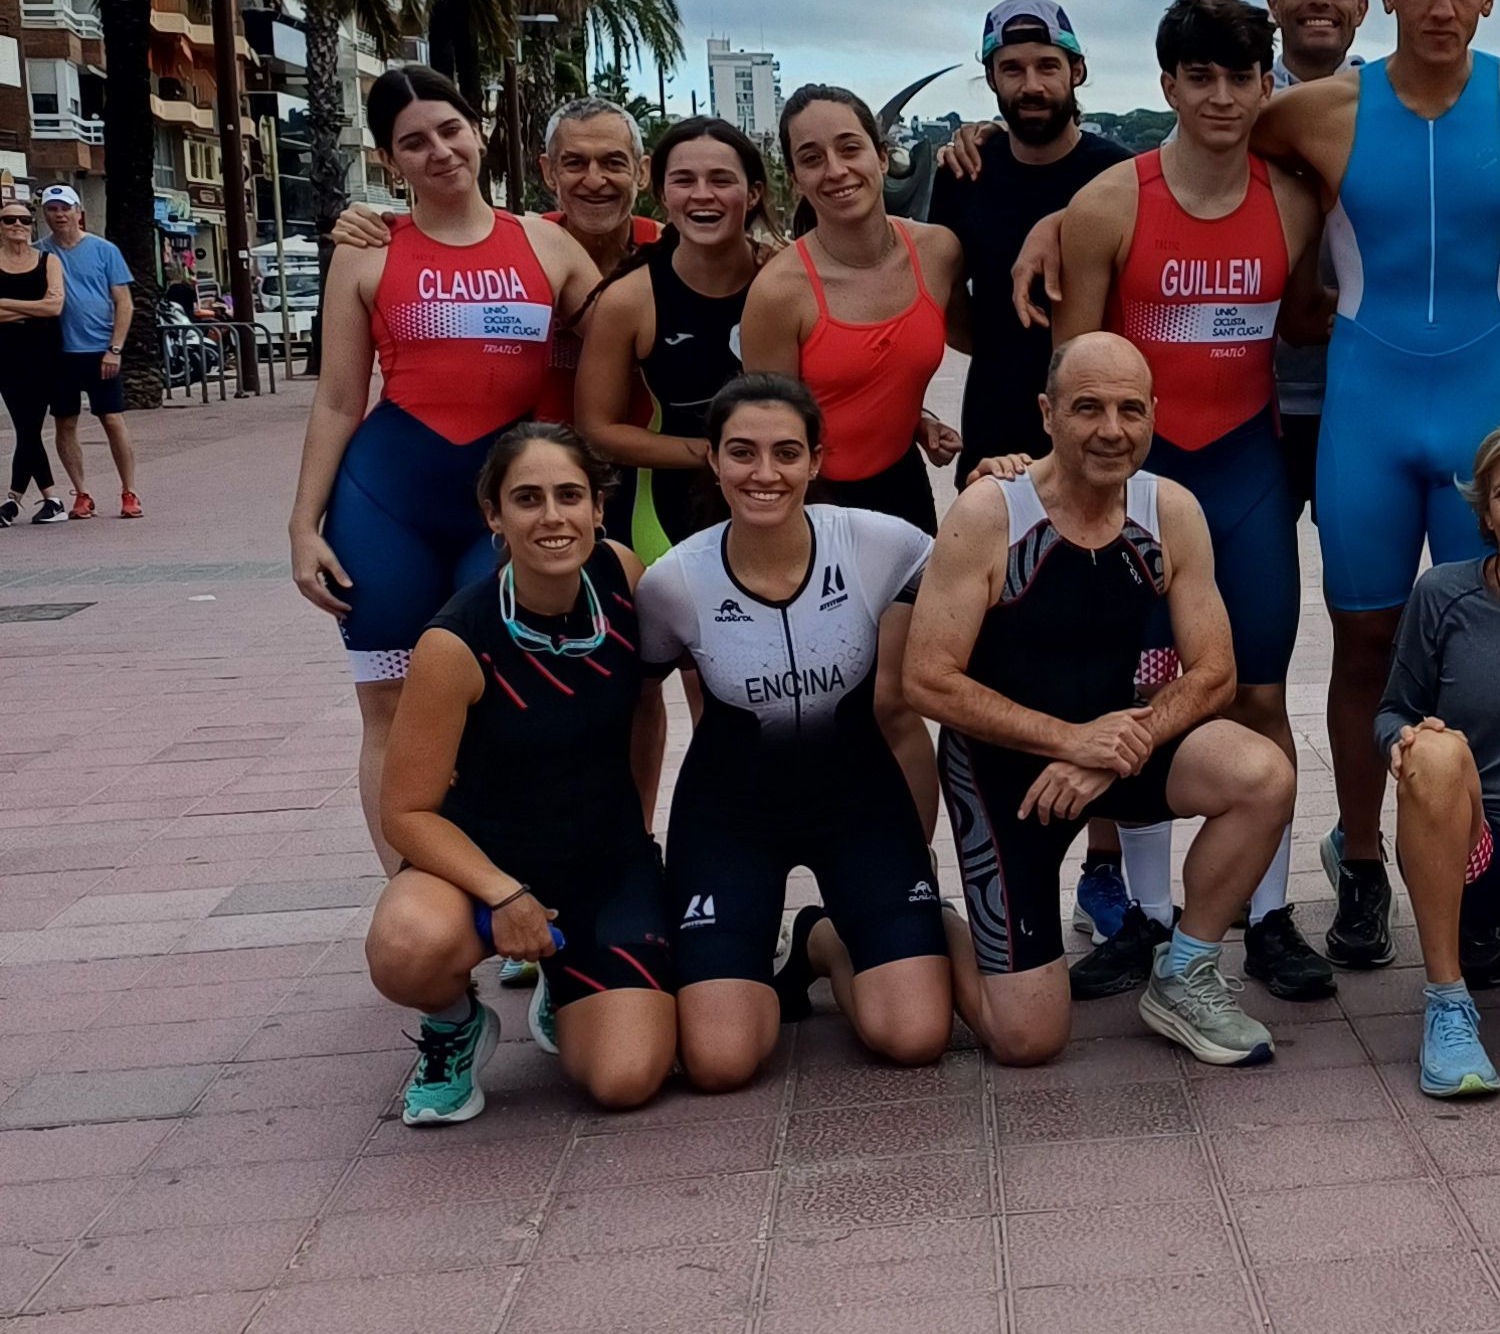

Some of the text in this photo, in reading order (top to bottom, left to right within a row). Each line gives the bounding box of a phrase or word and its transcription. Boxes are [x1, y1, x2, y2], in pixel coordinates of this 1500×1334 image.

[1161, 258, 1262, 297] GUILLEM
[418, 267, 529, 300] CLAUDIA
[482, 305, 509, 314] UNIÓ
[1215, 307, 1238, 316] UNIÓ
[484, 325, 509, 334] SANT
[1212, 328, 1235, 337] SANT
[744, 664, 846, 704] ENCINA
